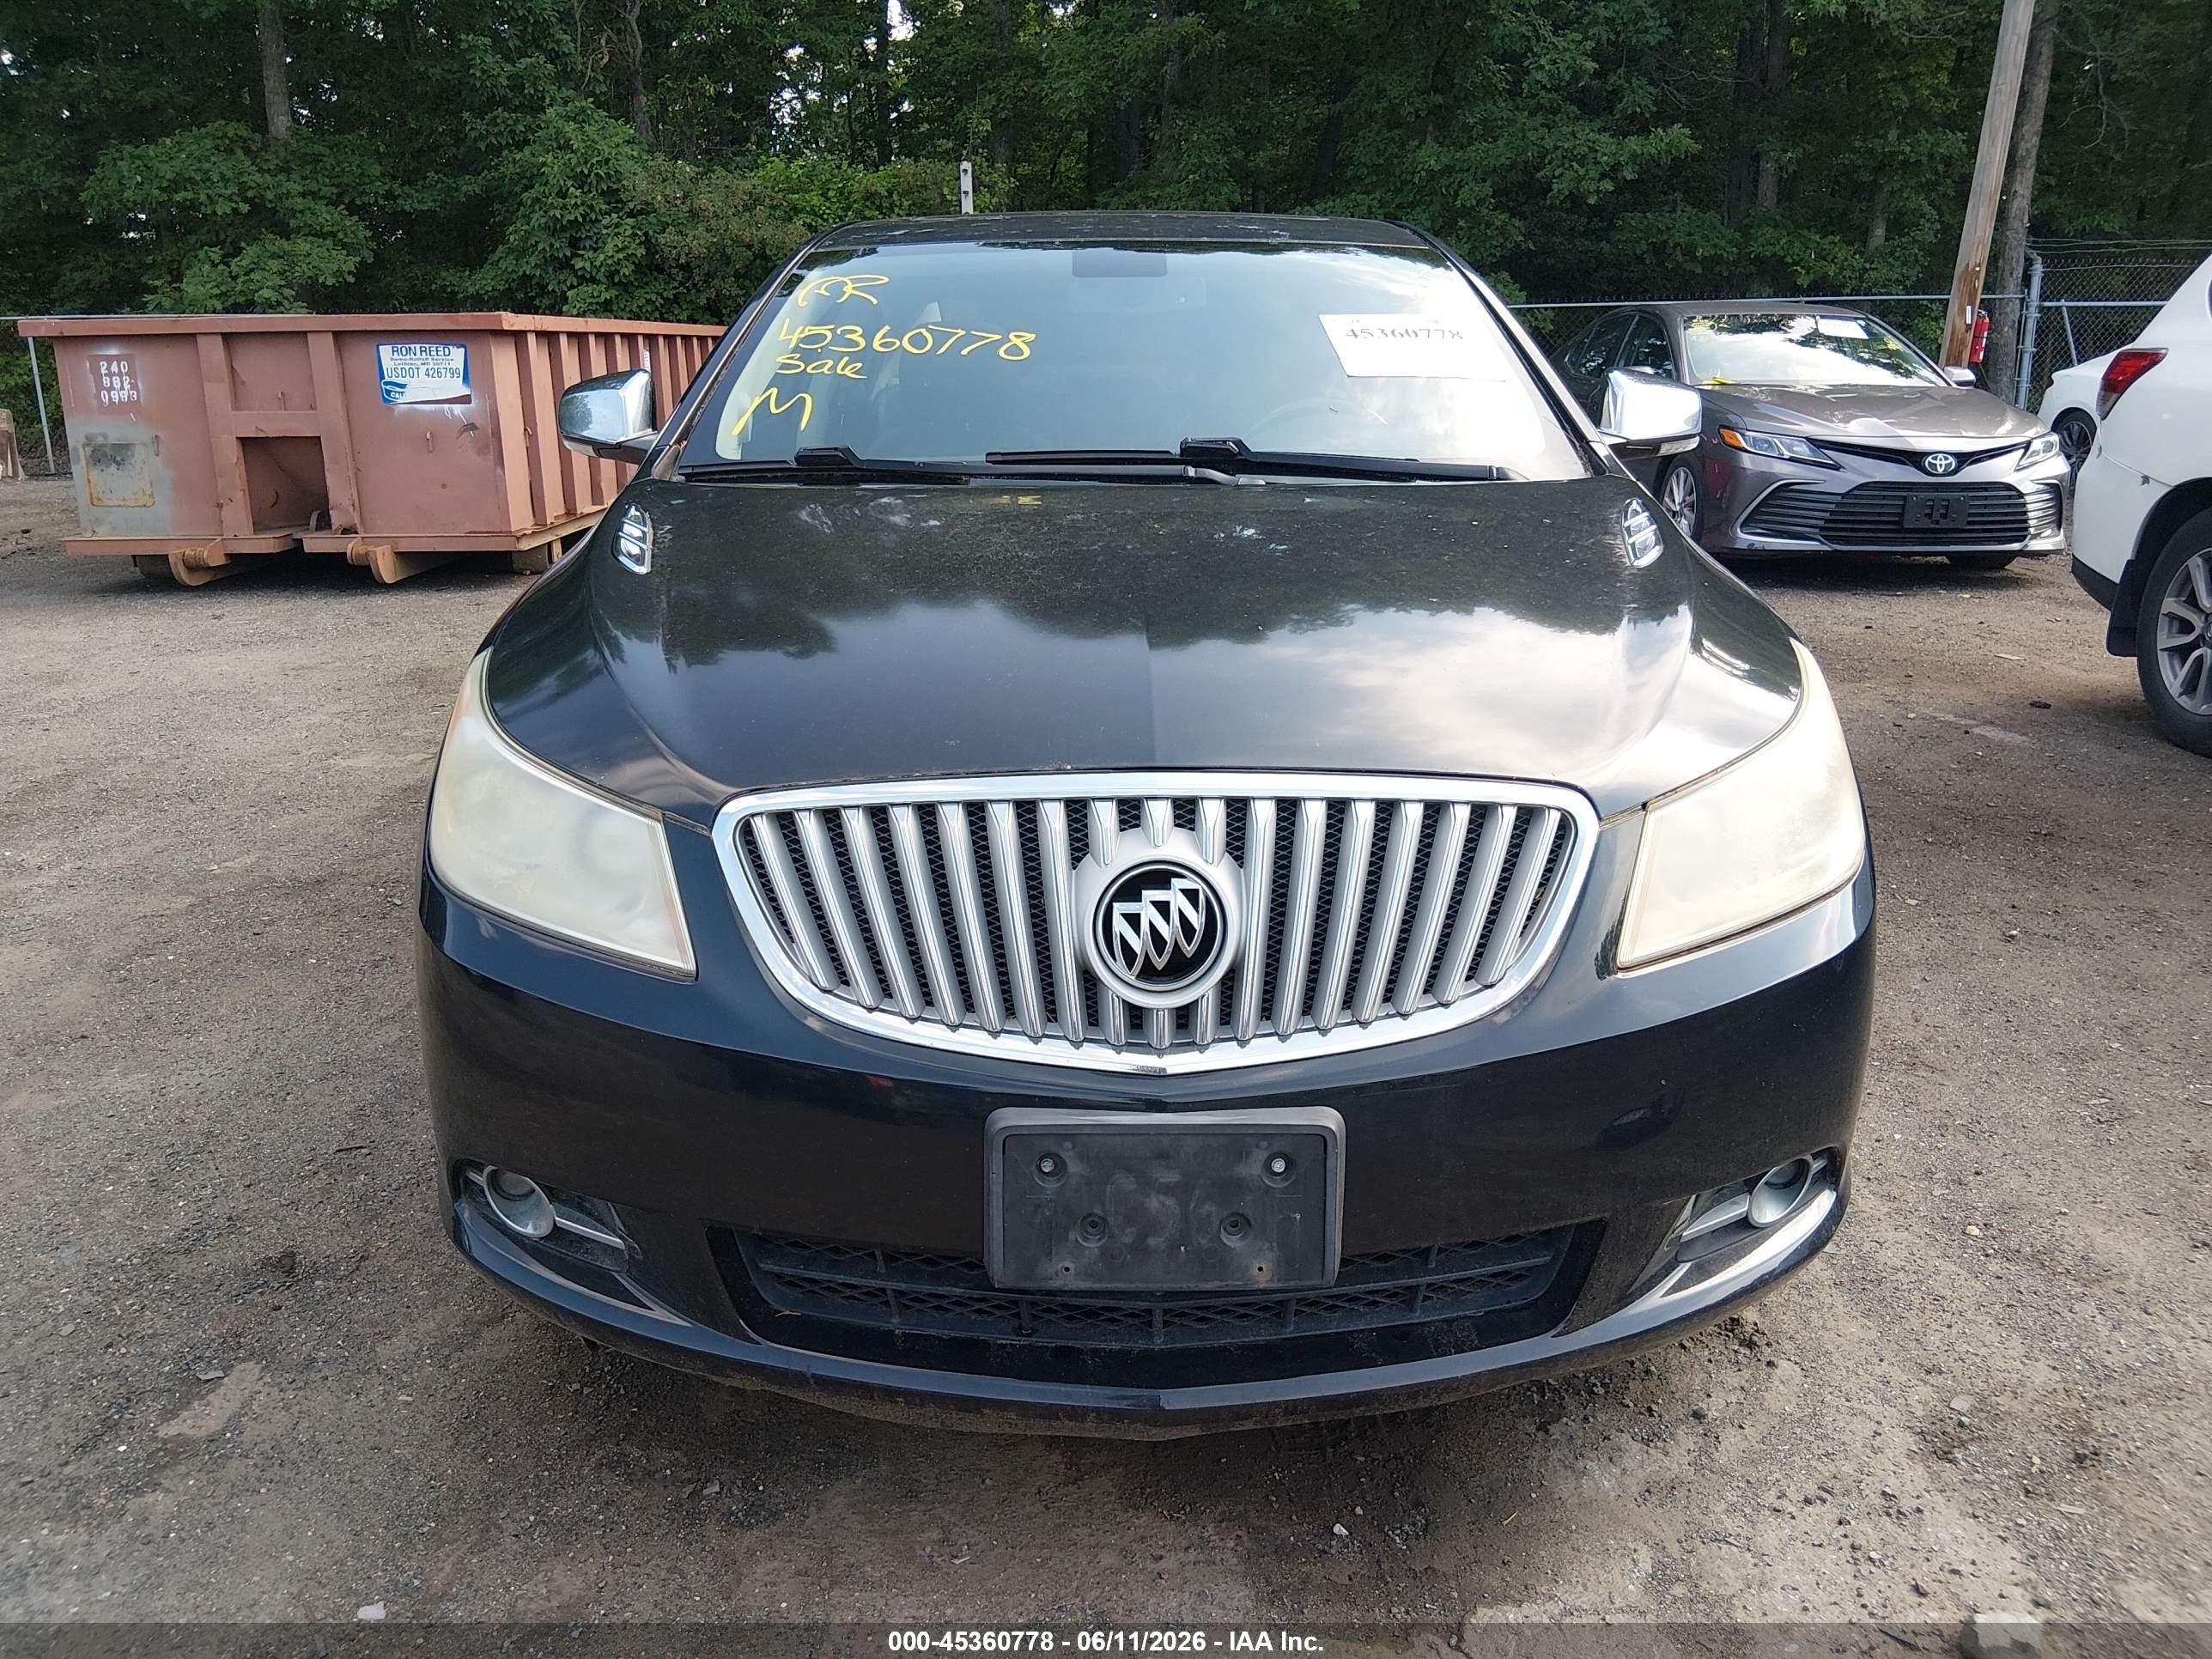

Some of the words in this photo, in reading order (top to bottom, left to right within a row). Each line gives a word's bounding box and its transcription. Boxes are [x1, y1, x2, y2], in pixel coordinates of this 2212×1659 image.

[778, 318, 1036, 361] 45360778
[1346, 328, 1463, 339] 45360778
[392, 346, 416, 356] RON
[419, 346, 451, 356] REED
[100, 361, 128, 374] 240
[775, 353, 867, 379] Sale
[386, 368, 421, 378] USDOT
[425, 367, 461, 378] 426799
